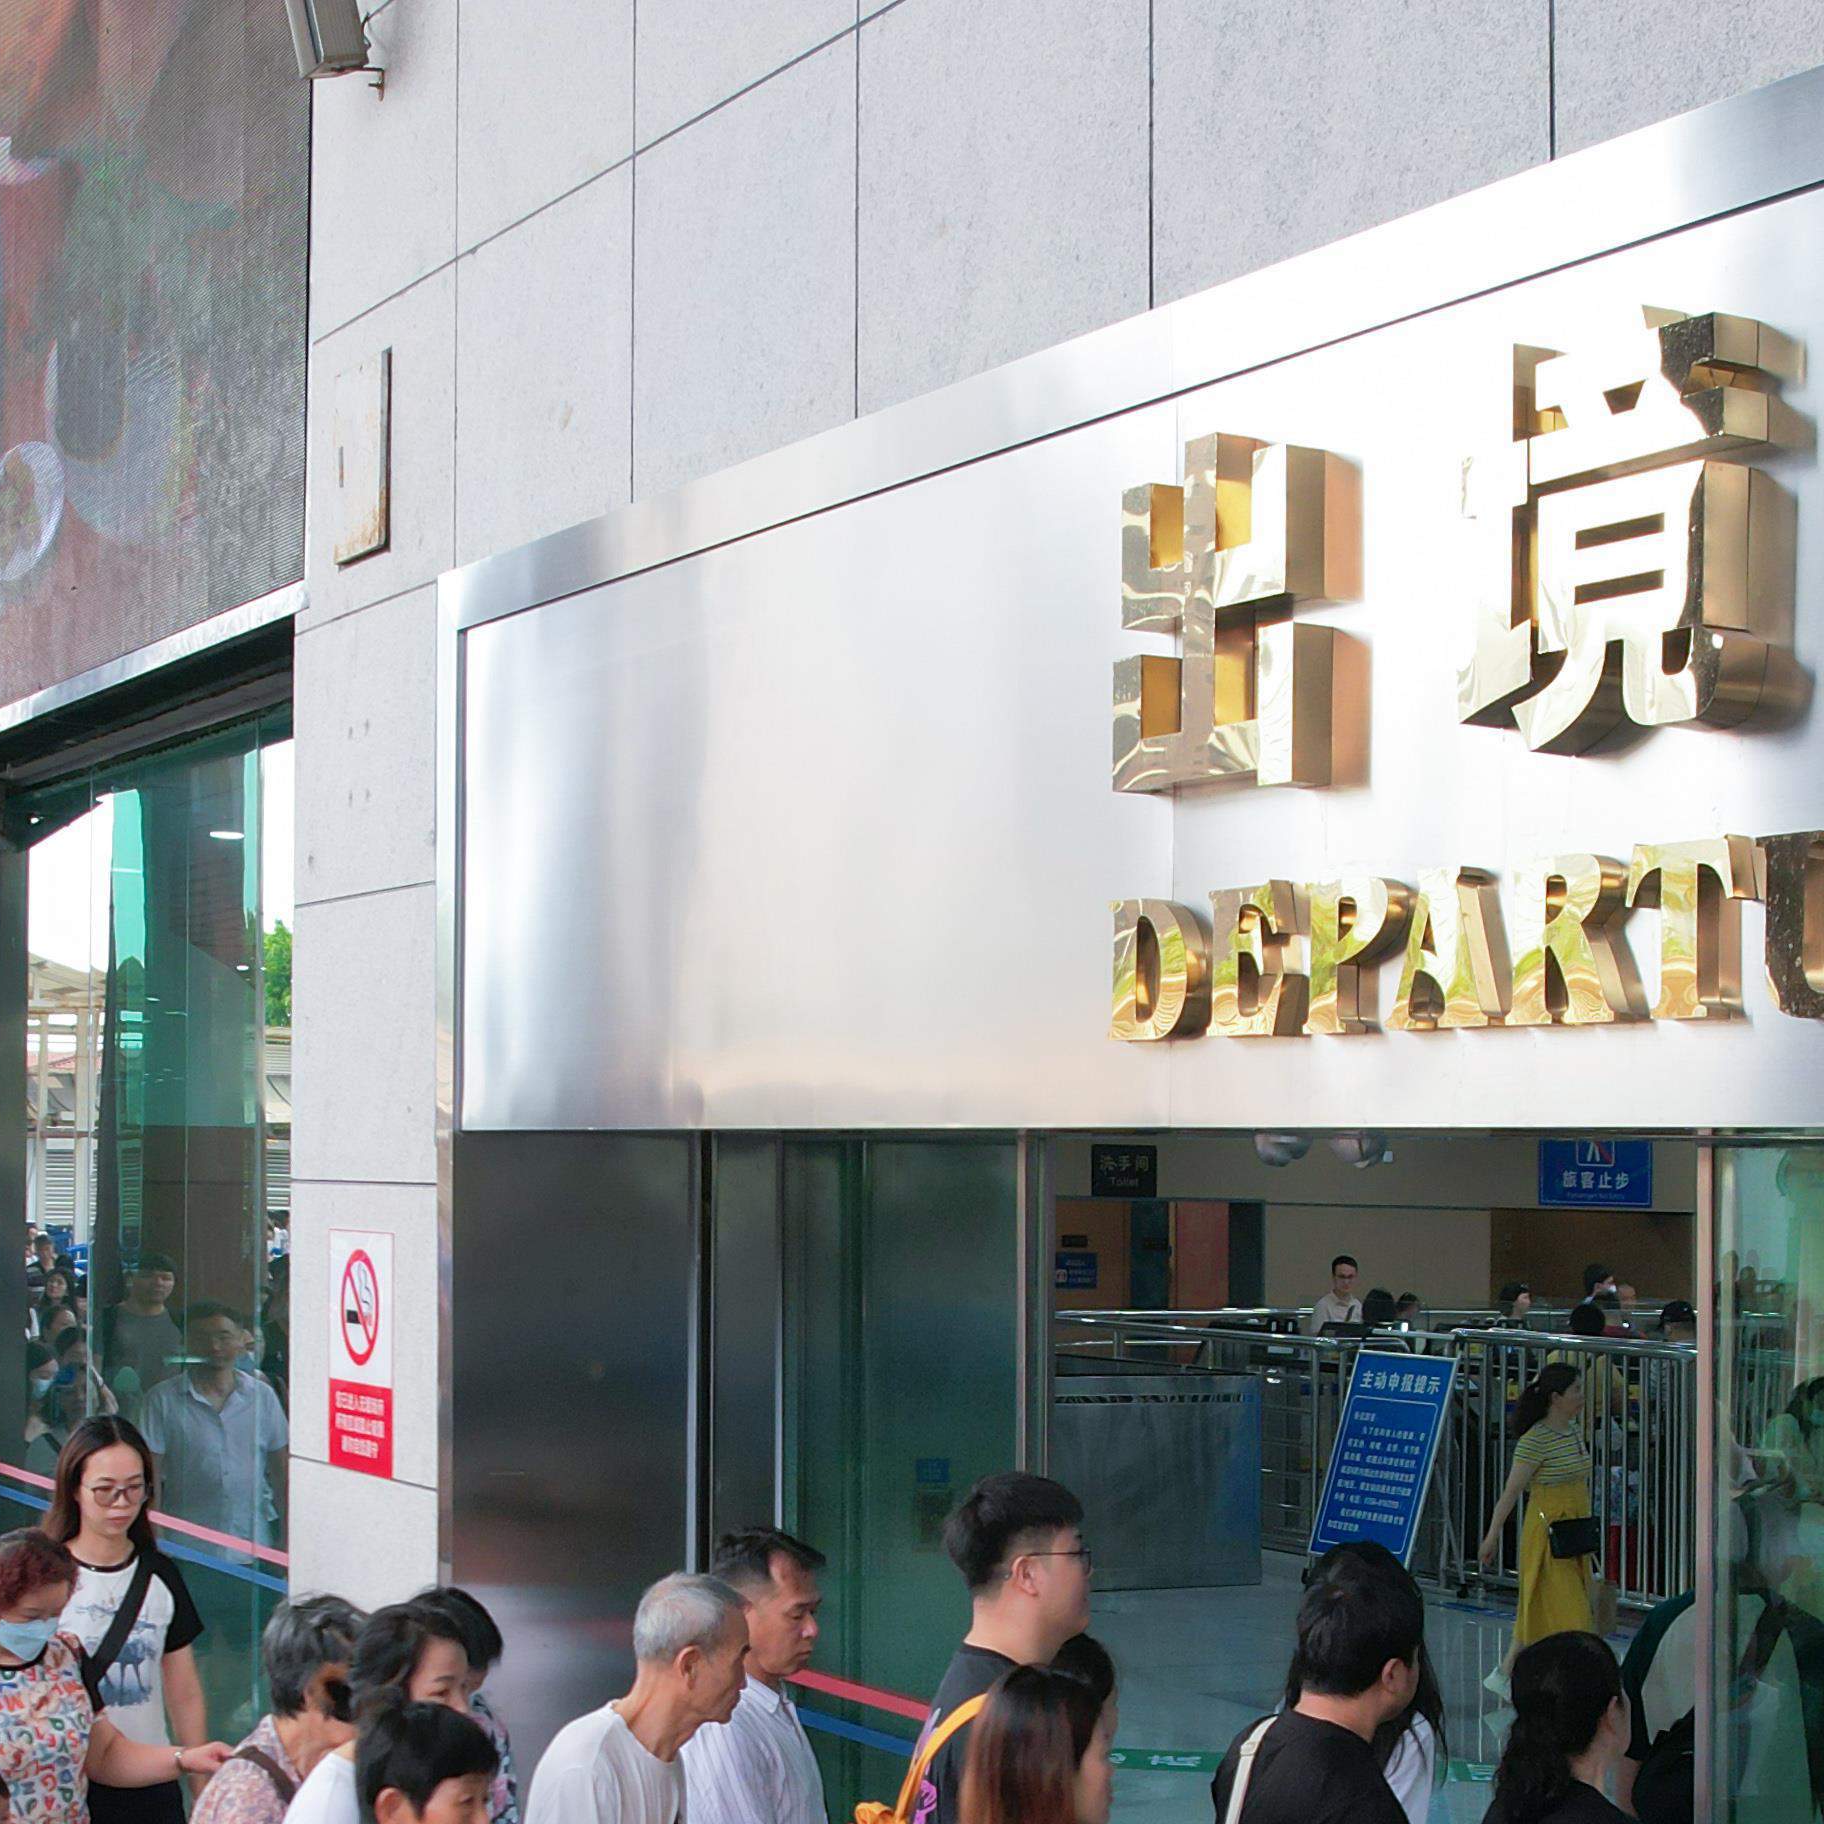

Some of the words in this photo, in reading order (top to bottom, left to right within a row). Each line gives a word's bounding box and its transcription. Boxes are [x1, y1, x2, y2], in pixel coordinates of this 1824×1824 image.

[1562, 1169, 1630, 1190] 旅客止步
[1359, 1370, 1442, 1396] 主动申报提示
